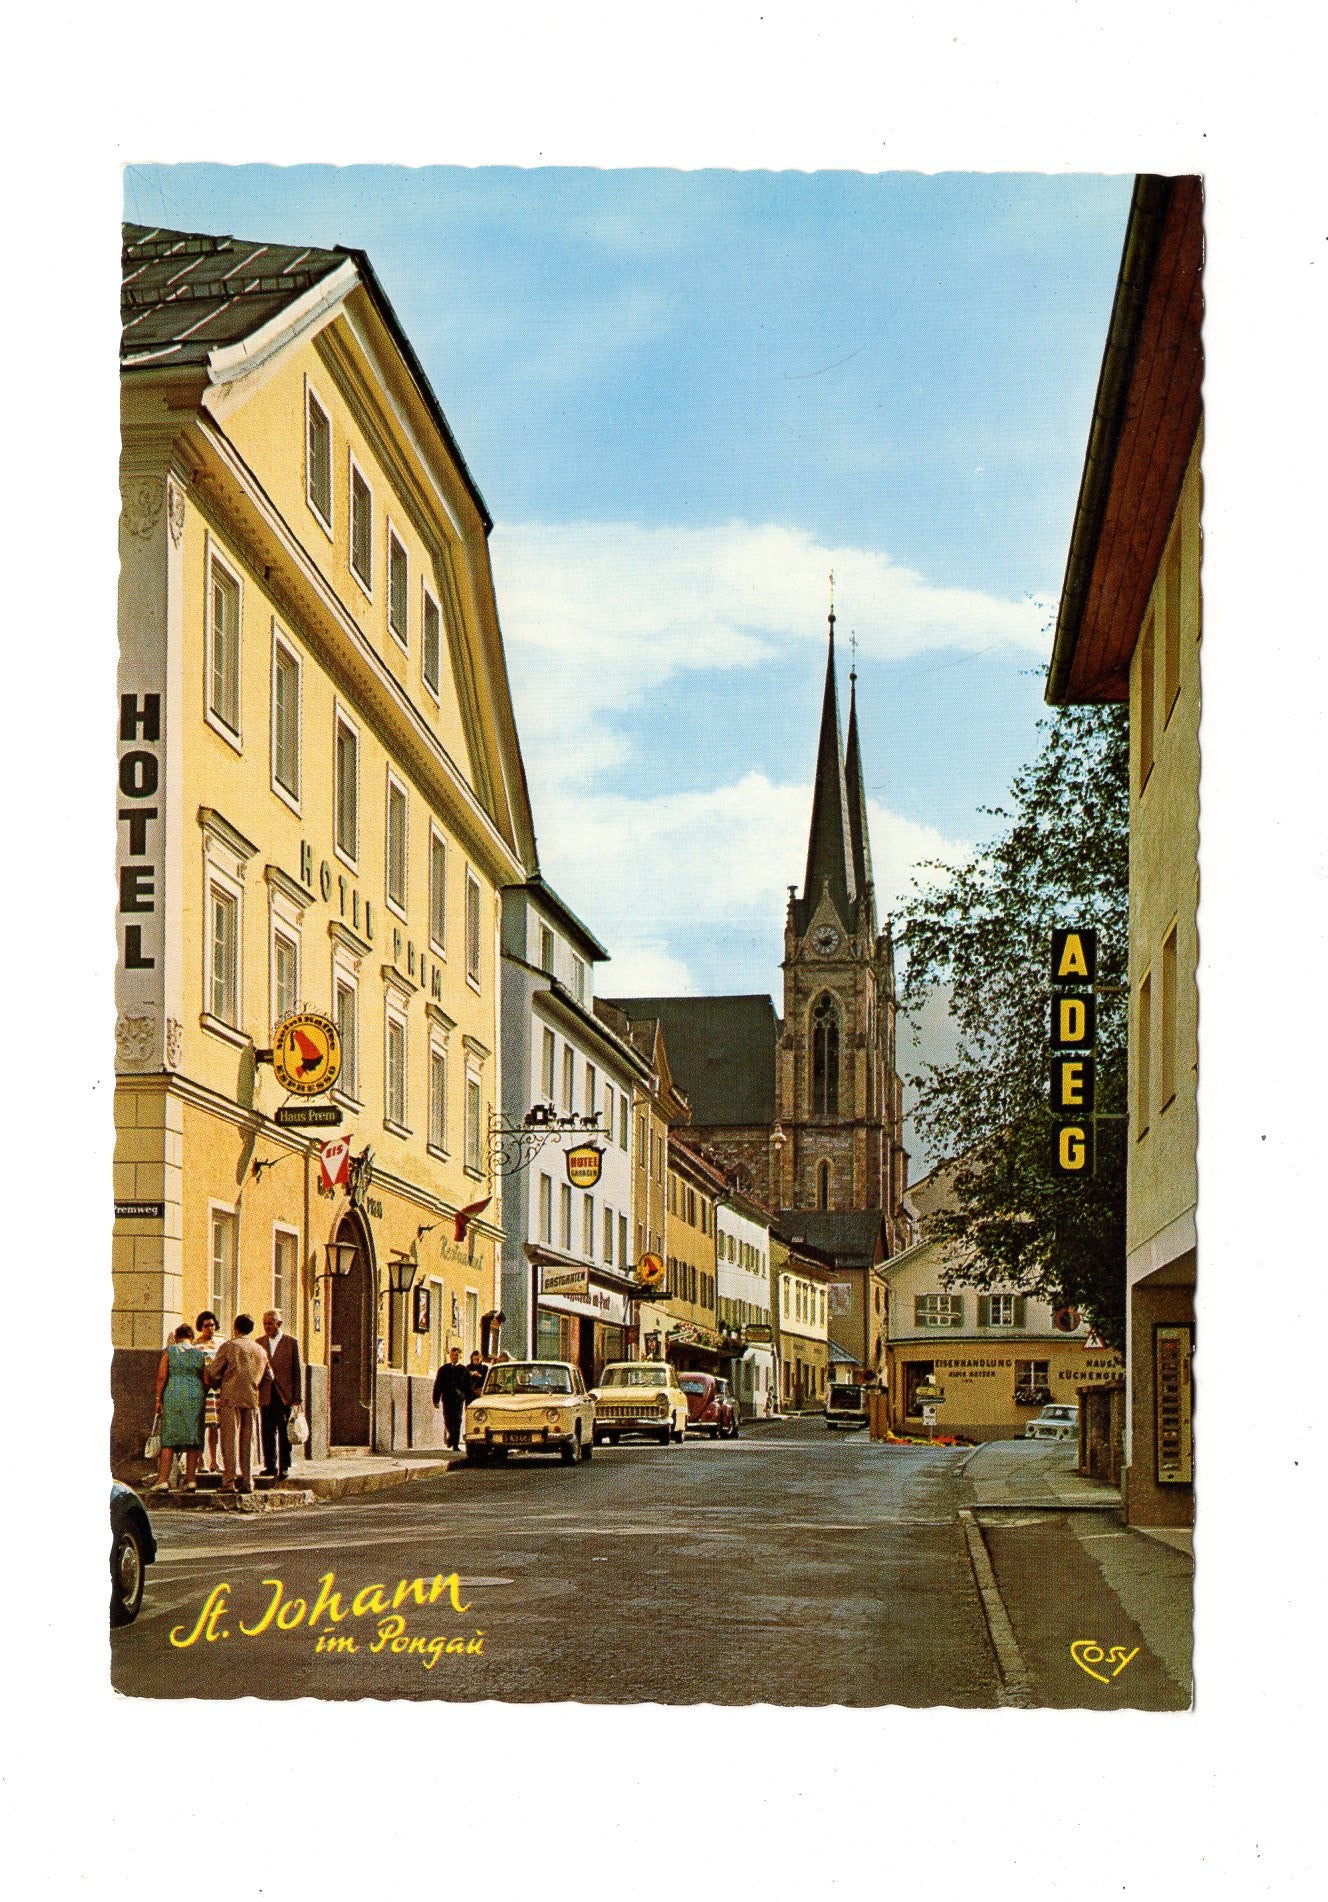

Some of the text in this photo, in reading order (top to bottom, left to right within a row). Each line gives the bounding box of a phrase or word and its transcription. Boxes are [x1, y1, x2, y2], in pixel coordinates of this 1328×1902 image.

[118, 693, 161, 970] HOTEL
[1058, 934, 1088, 1170] ADEG
[276, 1065, 336, 1091] ESPRESSO
[280, 1109, 336, 1122] Haus Prem
[325, 1144, 344, 1159] EIS
[570, 1157, 598, 1168] HOTEL
[935, 1359, 1013, 1368] EISENHANDLUNG
